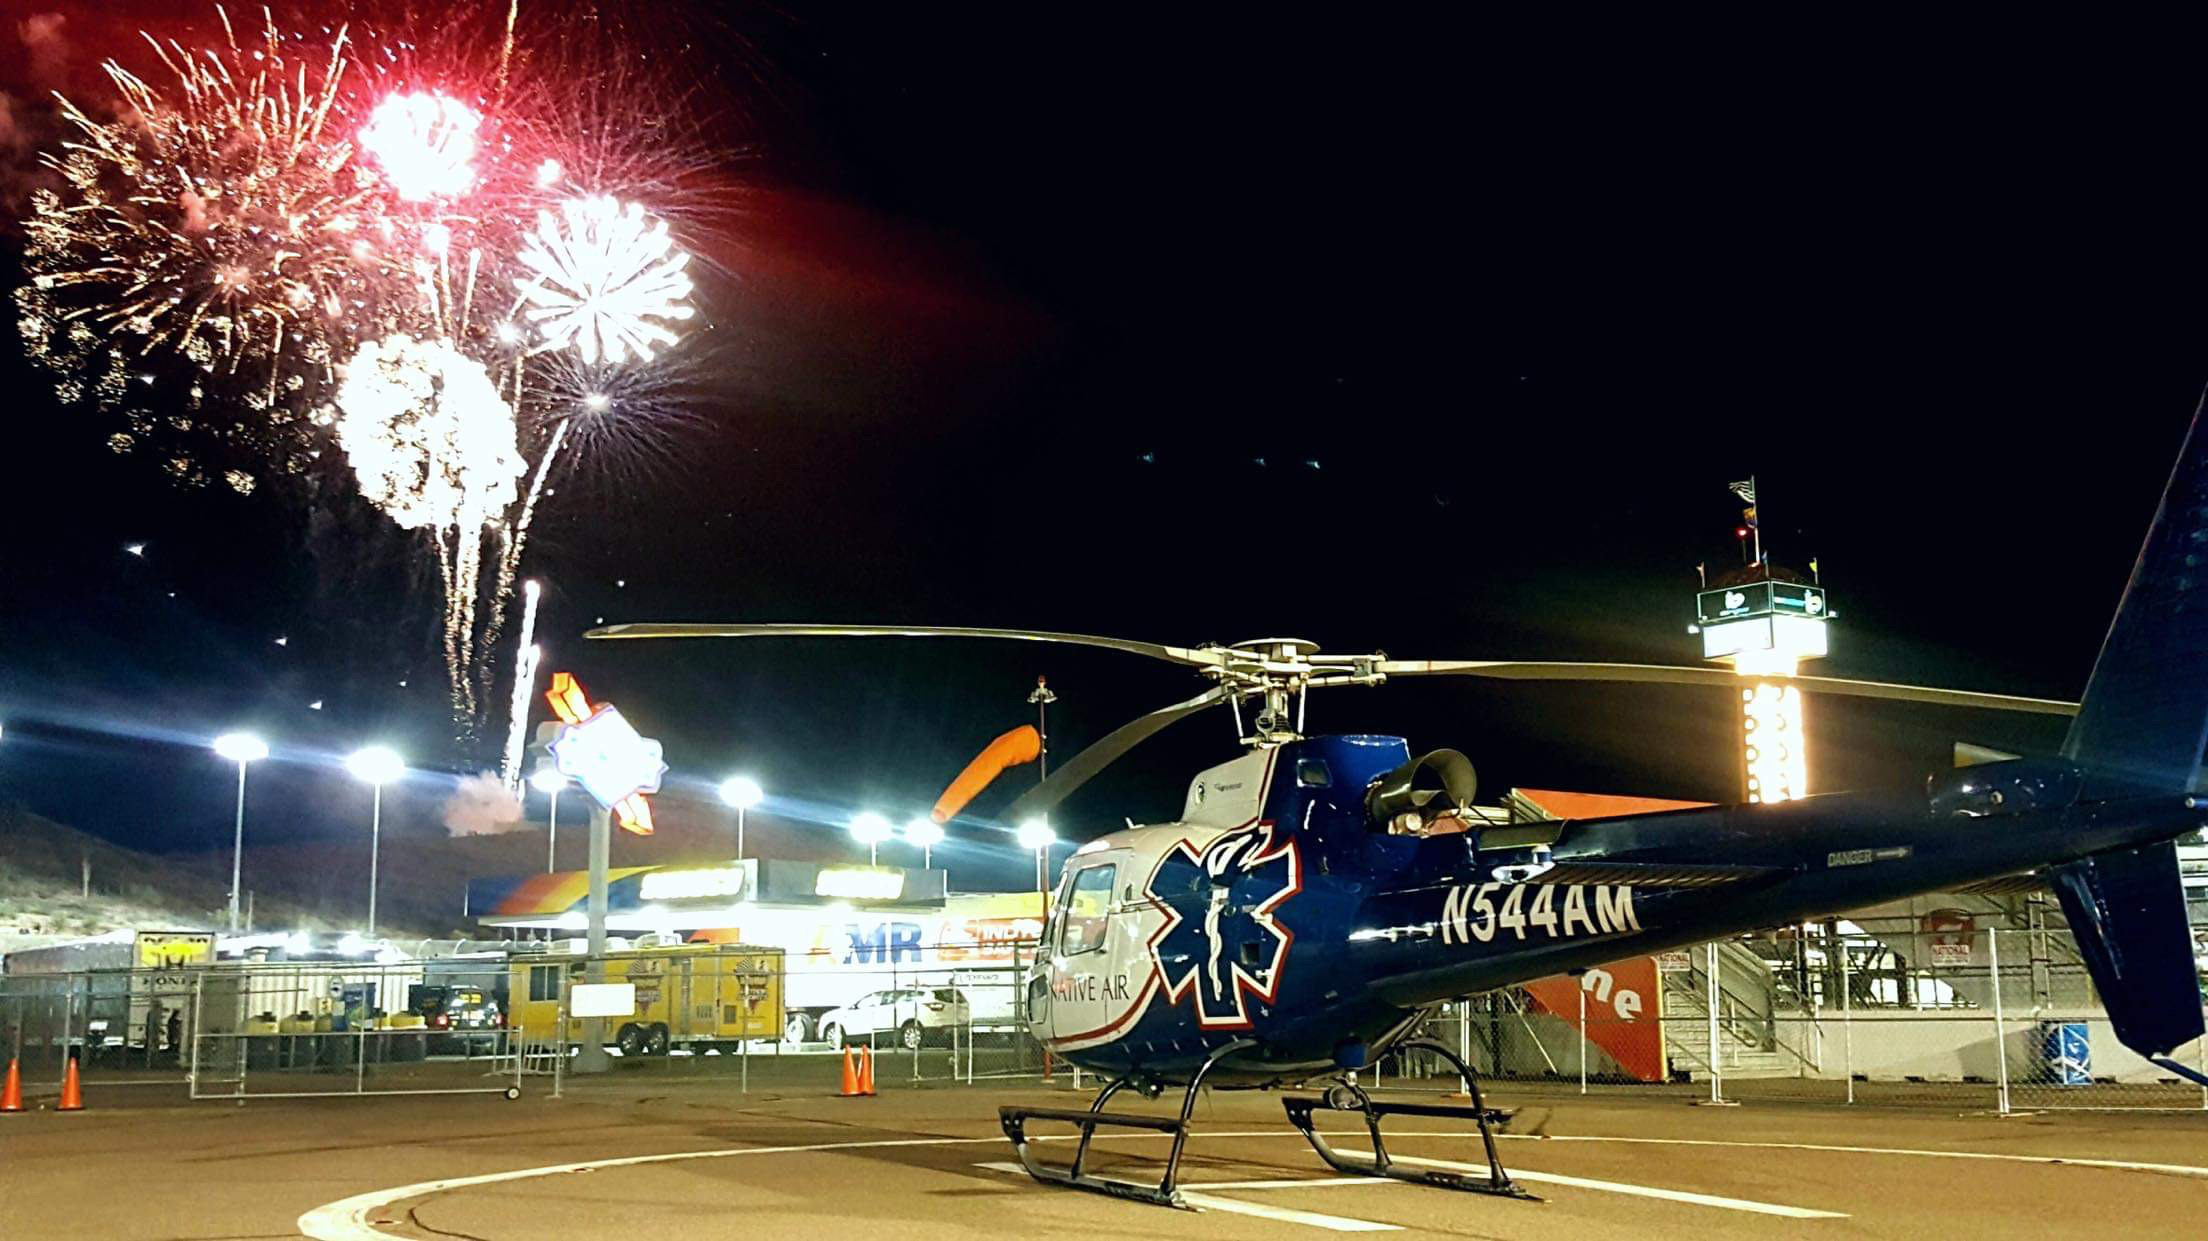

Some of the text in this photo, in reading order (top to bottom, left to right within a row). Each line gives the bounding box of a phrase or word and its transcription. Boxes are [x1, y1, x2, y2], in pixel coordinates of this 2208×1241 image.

[1827, 849, 1872, 867] DANGER
[1442, 882, 1643, 945] N544AM
[808, 922, 922, 964] AMR
[1051, 974, 1130, 1002] NATIVE AIR
